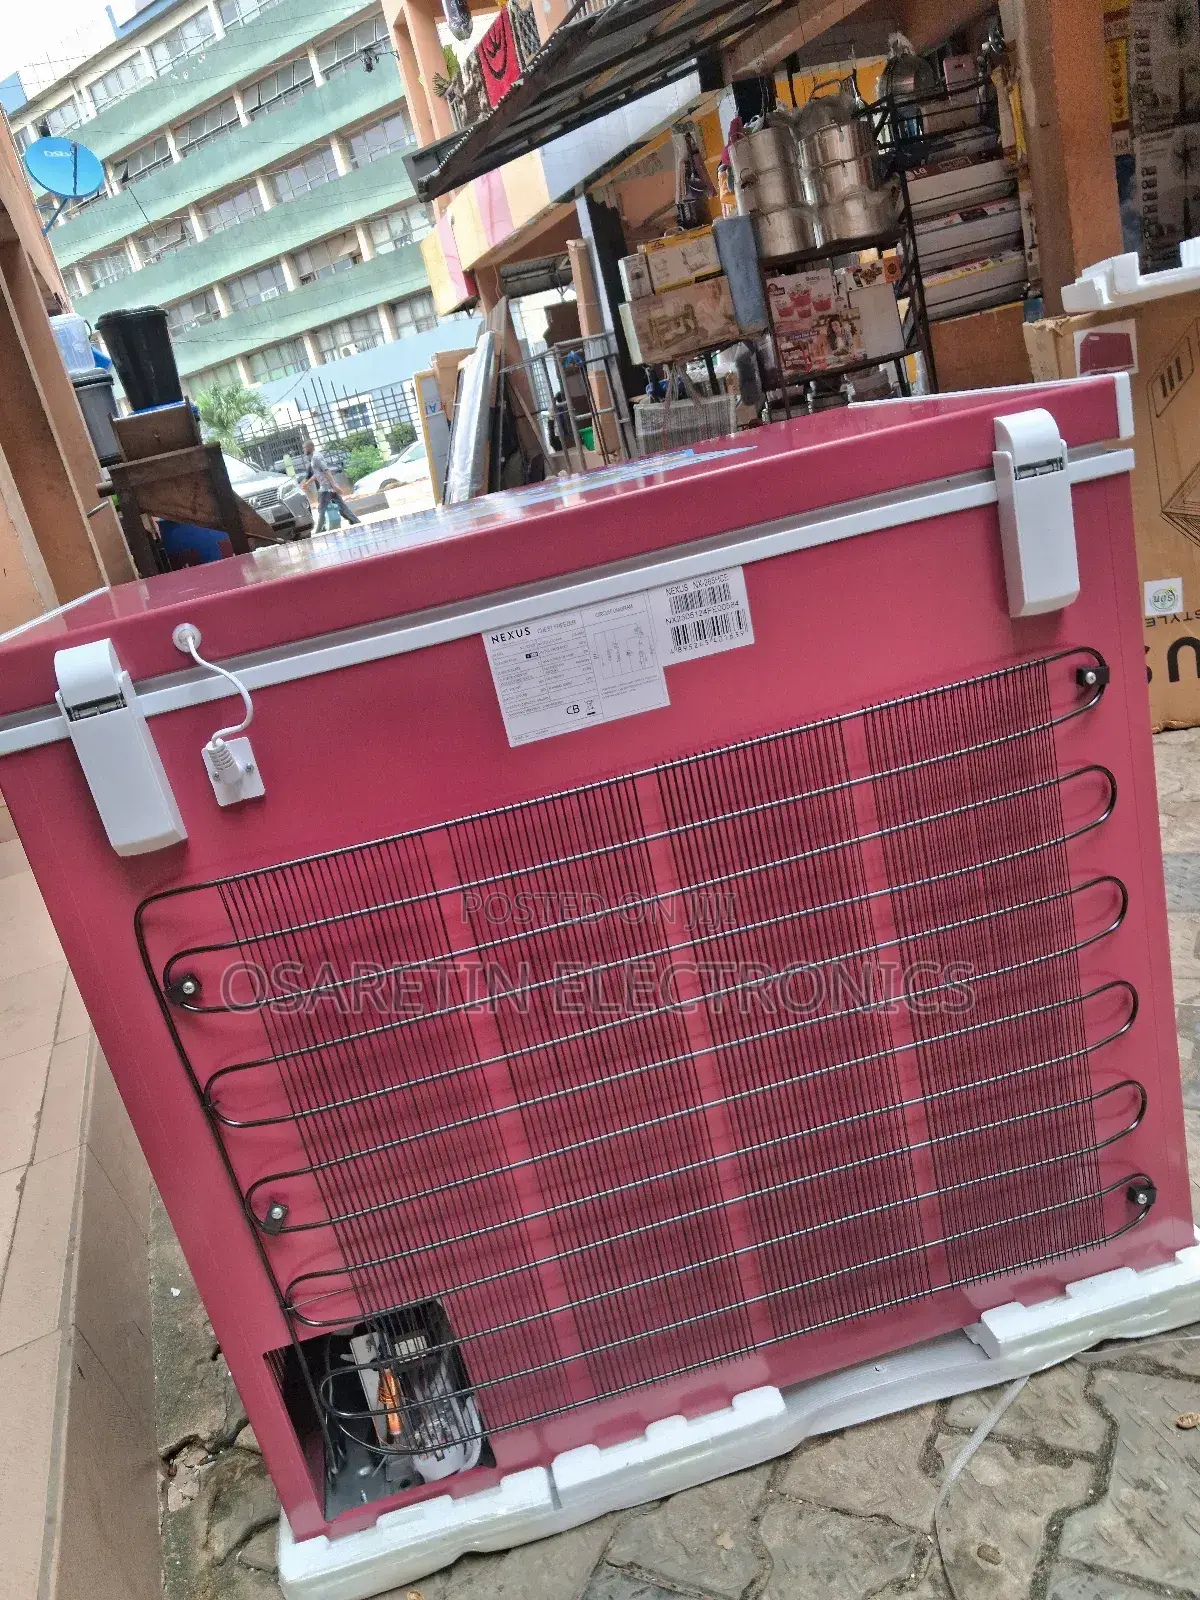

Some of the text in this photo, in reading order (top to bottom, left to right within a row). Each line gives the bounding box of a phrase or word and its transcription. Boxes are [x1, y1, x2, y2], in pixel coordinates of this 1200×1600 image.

[913, 167, 928, 177] LG
[665, 584, 689, 597] NEXUS
[491, 626, 532, 645] NEXUS
